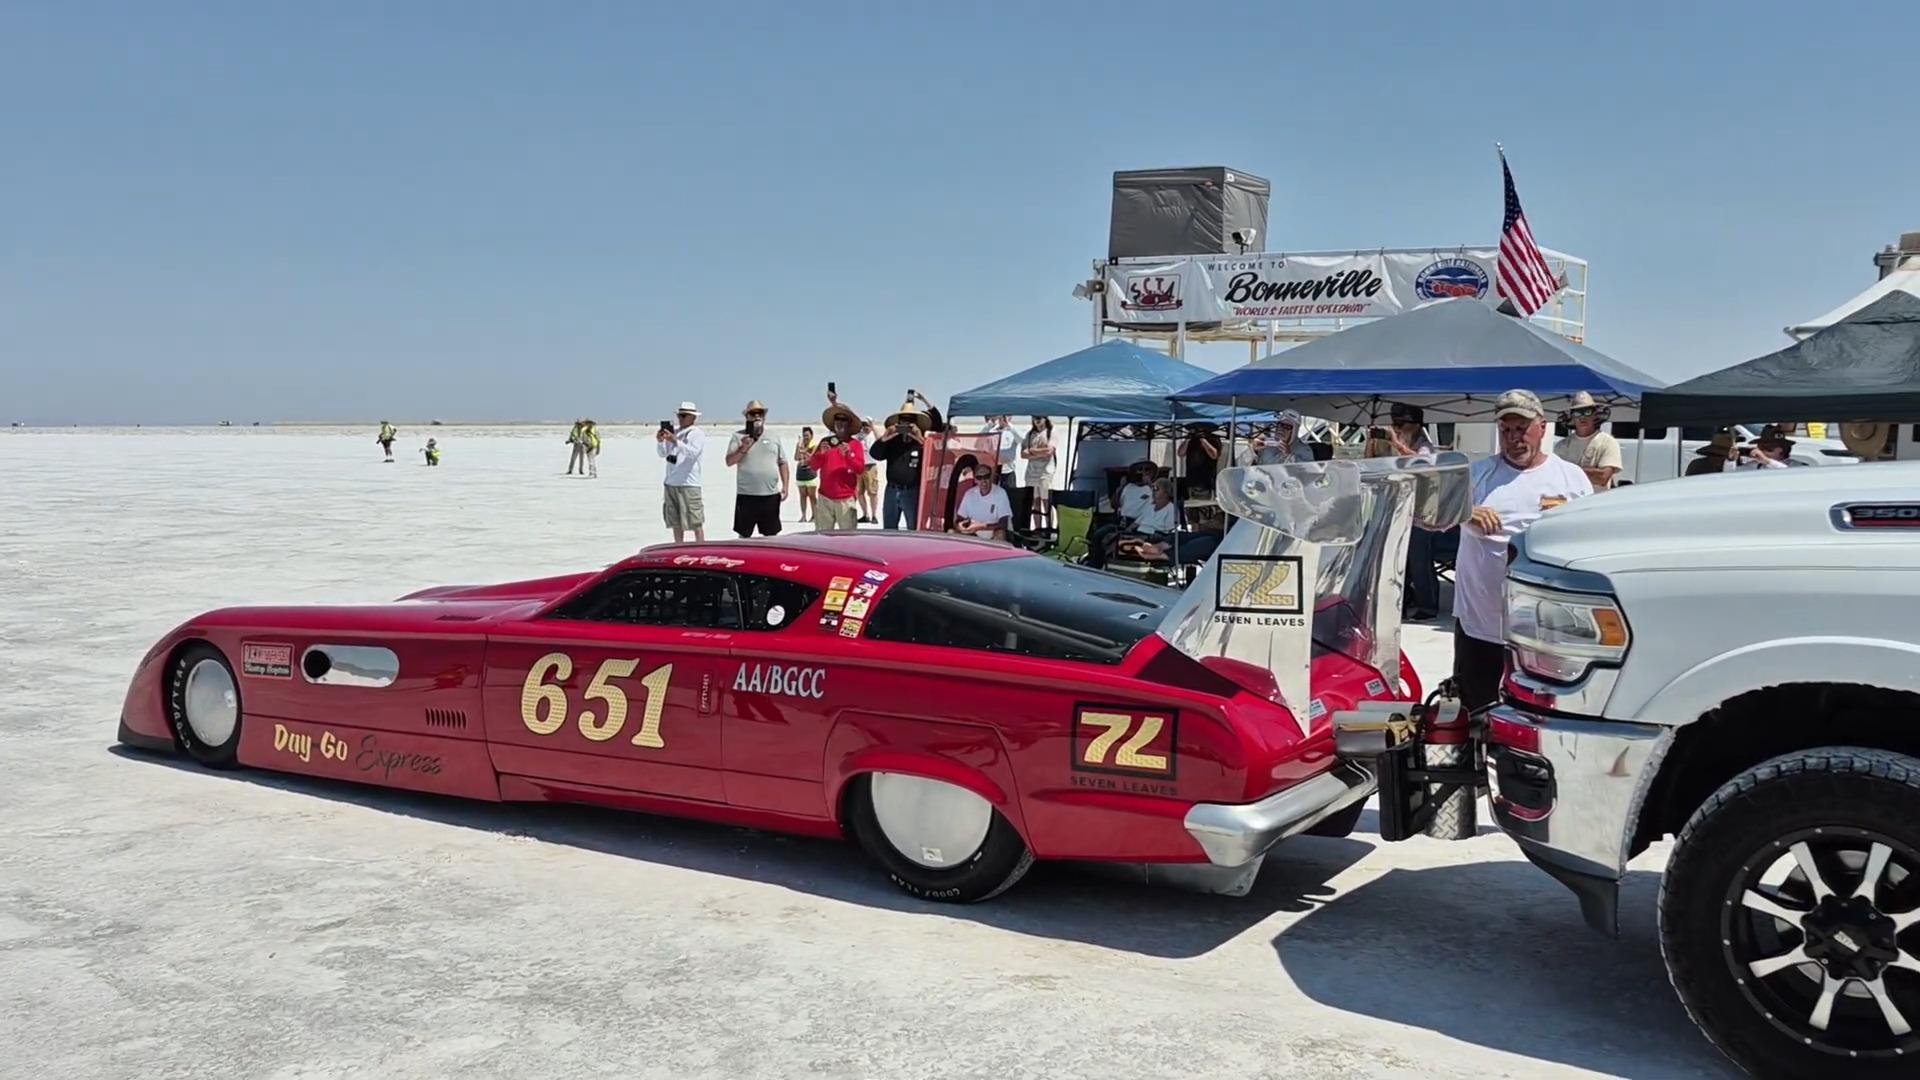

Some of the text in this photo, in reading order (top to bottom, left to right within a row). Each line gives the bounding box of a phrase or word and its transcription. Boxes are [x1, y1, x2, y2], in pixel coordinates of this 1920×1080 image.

[1207, 261, 1285, 271] WELCOME TO
[1225, 269, 1383, 303] Bonneville
[1279, 305, 1314, 315] FASTEST
[1214, 615, 1305, 627] SEVEN LEAVES
[733, 662, 826, 699] AA/BGCC
[521, 652, 673, 748] 651
[320, 730, 349, 761] Go
[356, 734, 441, 780] Express
[1071, 776, 1178, 796] SEVEN LEAVES
